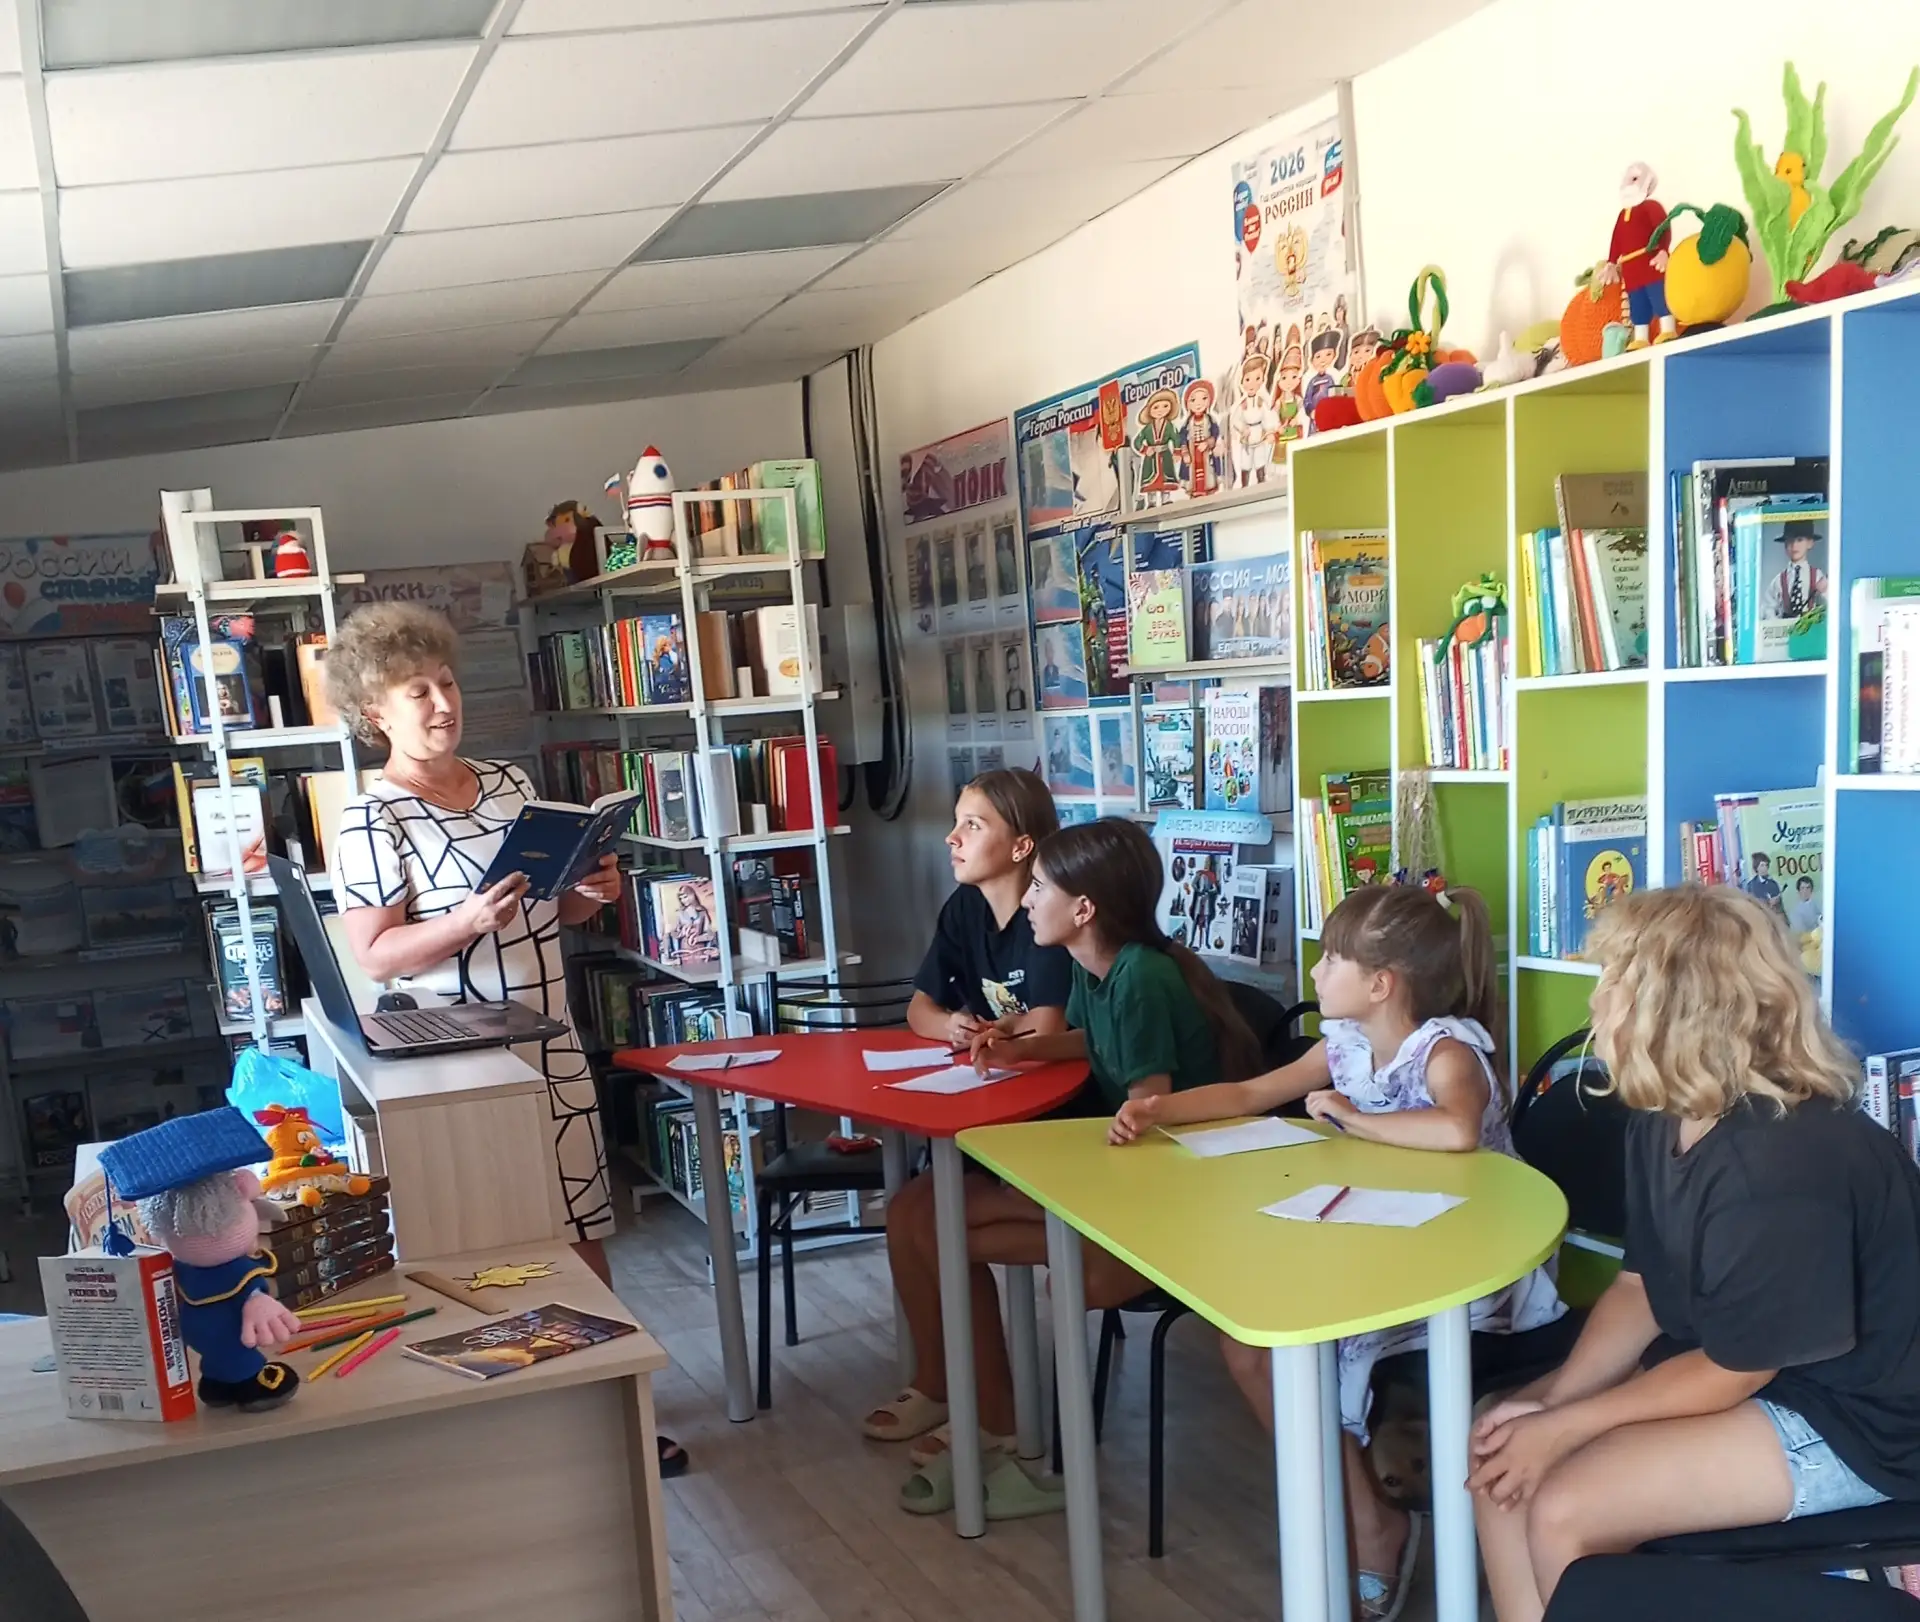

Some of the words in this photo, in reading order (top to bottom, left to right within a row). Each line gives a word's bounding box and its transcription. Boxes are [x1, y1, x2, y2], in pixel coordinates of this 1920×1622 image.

[1270, 146, 1305, 186] 2026
[1264, 187, 1313, 224] РОССИИ
[1158, 366, 1184, 390] СВО
[1029, 416, 1056, 437] Герои
[1057, 403, 1093, 427] России
[1193, 568, 1251, 592] РОССИЯ
[1152, 620, 1176, 629] ВЕНОК
[1147, 629, 1181, 640] ДРУЖБЫ
[1213, 707, 1250, 719] НАРОДЫ
[1213, 723, 1250, 736] РОССИИ
[1227, 820, 1260, 834] РОДНОЙ
